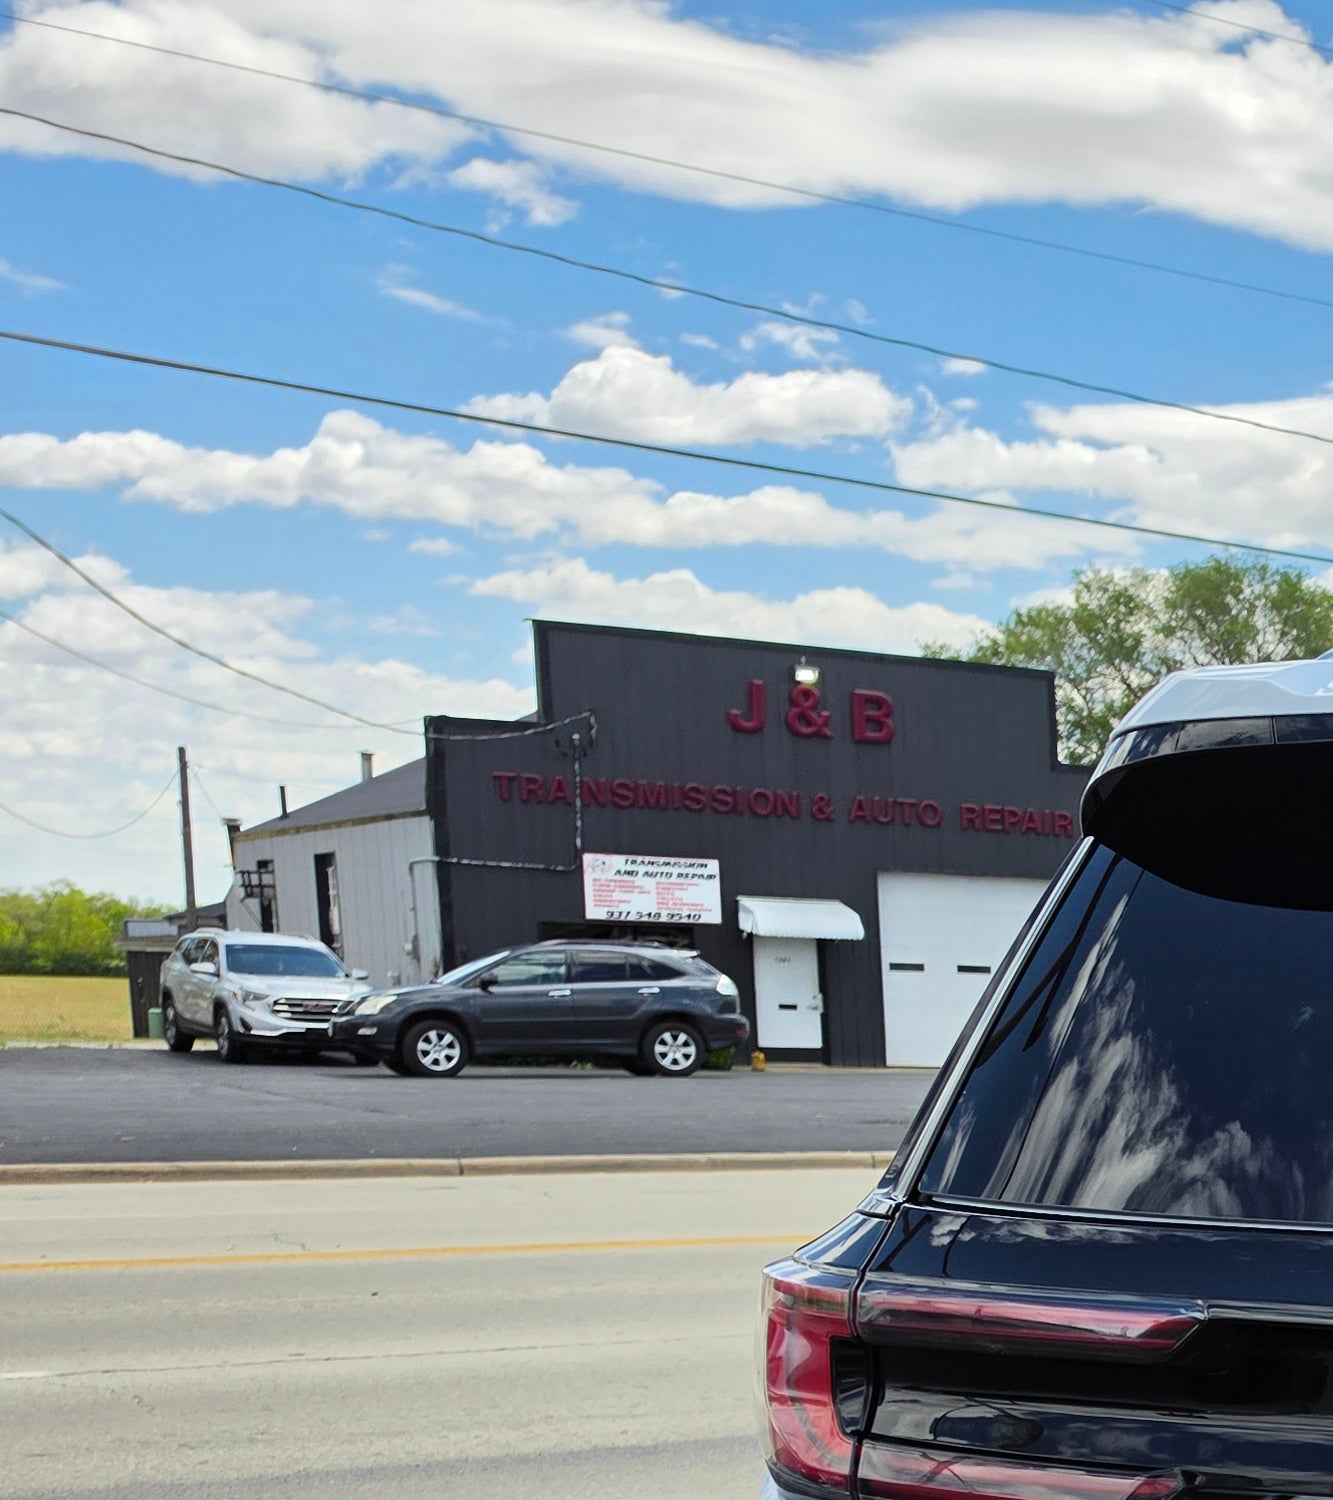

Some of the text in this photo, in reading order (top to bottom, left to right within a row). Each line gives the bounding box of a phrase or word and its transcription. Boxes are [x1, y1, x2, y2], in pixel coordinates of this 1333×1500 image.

[727, 679, 896, 744] J & B
[492, 771, 1074, 838] TRANSMISSION & AUTO REPAIR
[642, 870, 673, 879] AUTO
[676, 872, 717, 881] REPAIR
